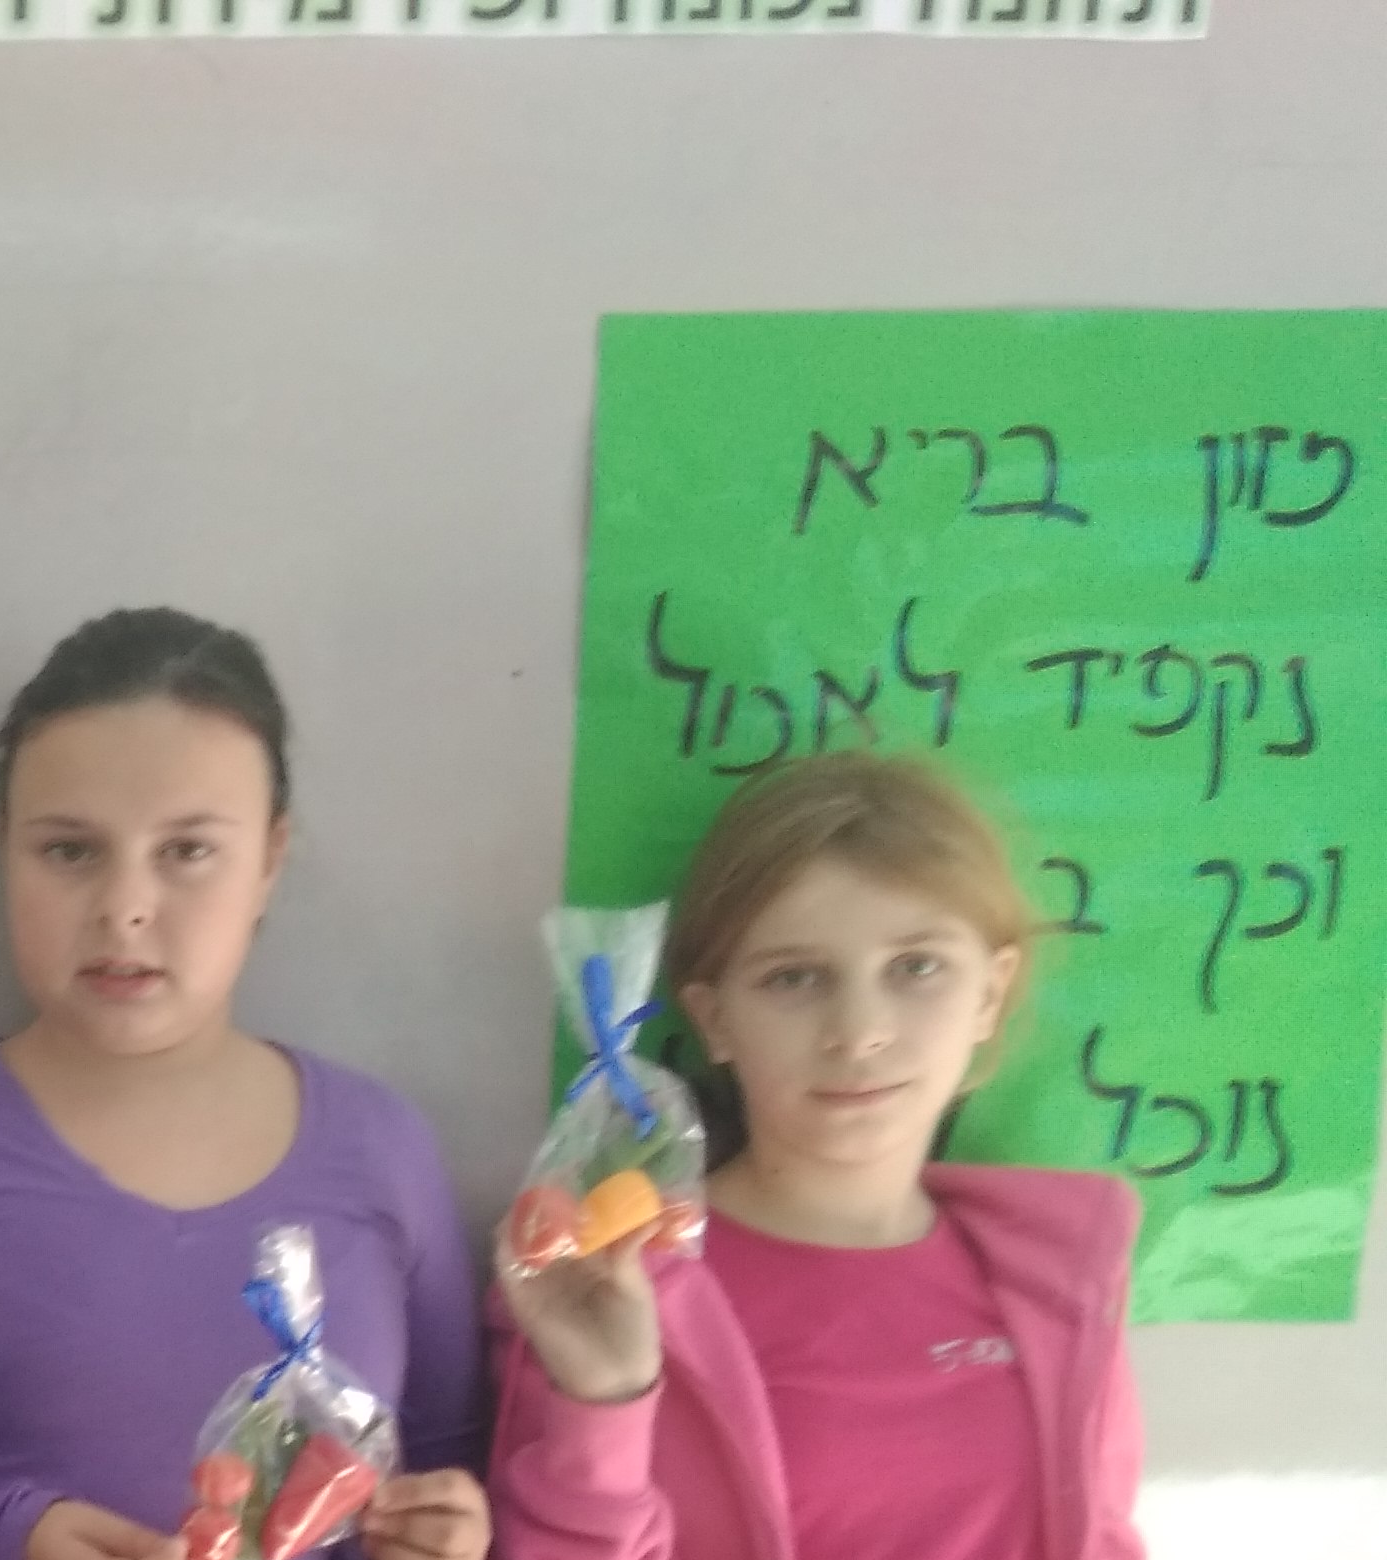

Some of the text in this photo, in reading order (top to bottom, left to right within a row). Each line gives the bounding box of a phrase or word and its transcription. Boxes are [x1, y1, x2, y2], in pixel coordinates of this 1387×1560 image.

[793, 424, 1090, 535] בריא
[646, 590, 1317, 800] נקפיד לאכול
[1194, 847, 1347, 1013] וכך
[1081, 1025, 1293, 1195] נוכל
